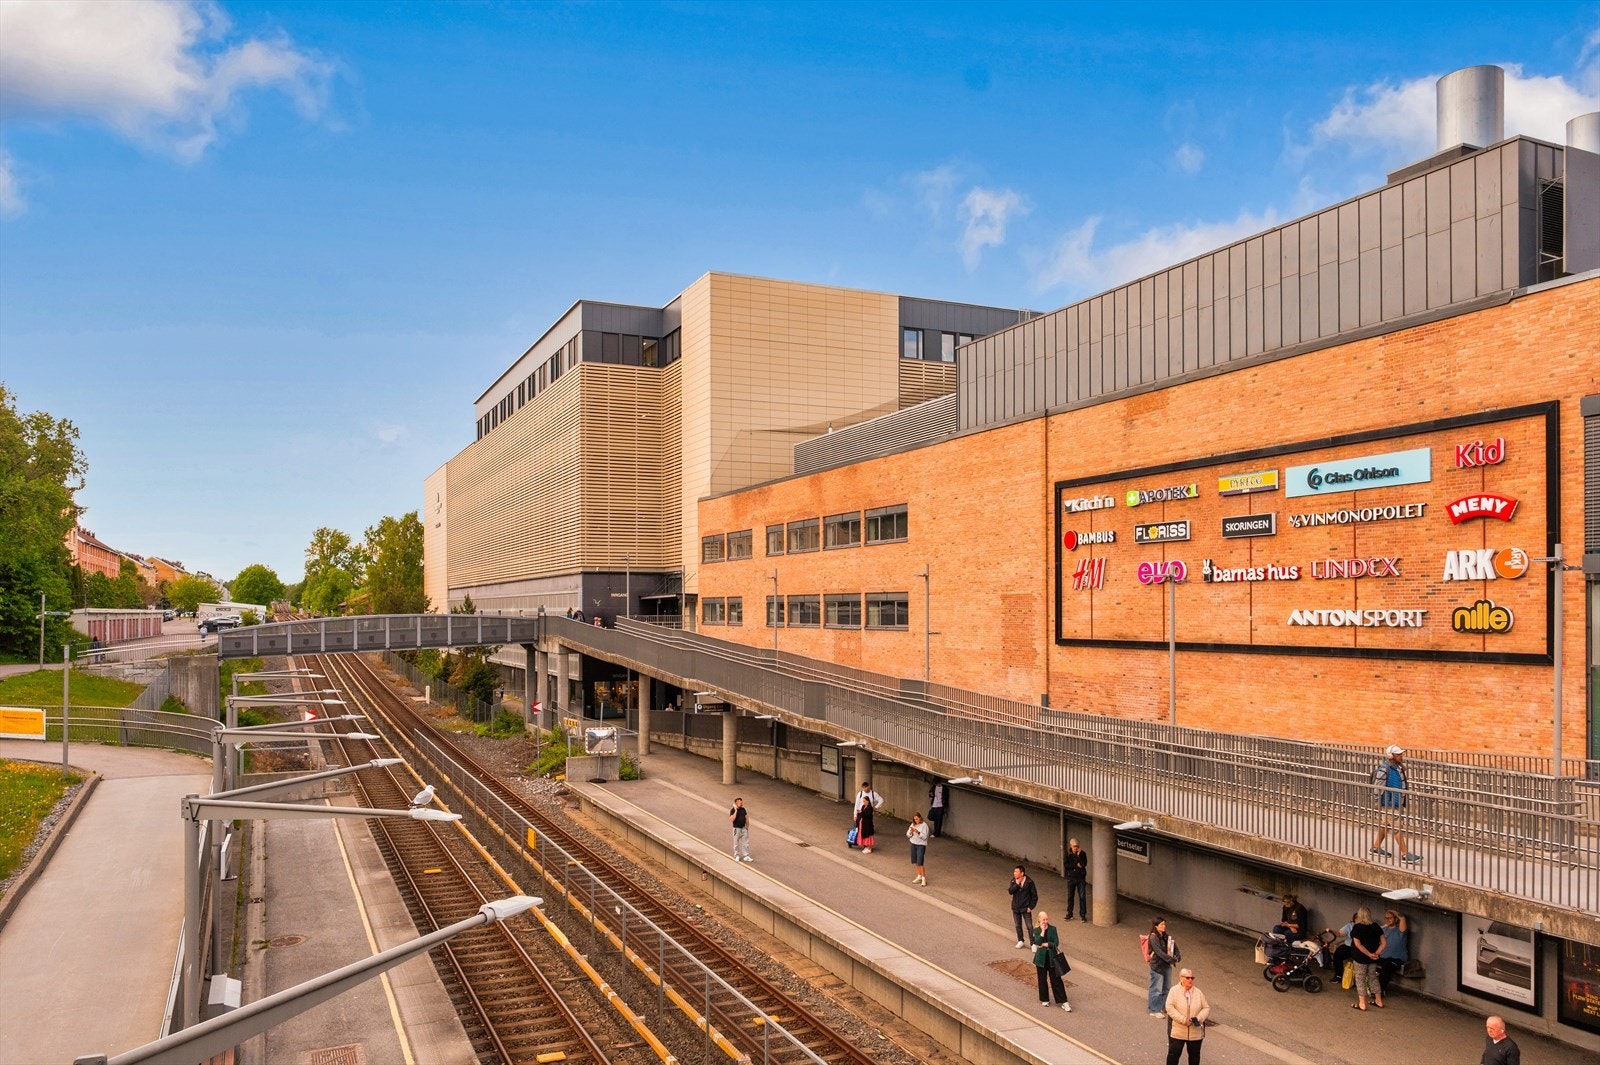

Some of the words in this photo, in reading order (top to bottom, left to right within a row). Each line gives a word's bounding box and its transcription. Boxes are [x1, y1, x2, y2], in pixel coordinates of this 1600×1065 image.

[1455, 437, 1505, 468] Kid
[1324, 472, 1353, 485] Clas
[1353, 466, 1400, 481] Ohlson
[1071, 494, 1115, 512] Kitch'n
[1450, 497, 1509, 518] MENY
[1301, 502, 1426, 526] VINMONOPOLET
[1135, 523, 1186, 540] FLORISS
[1225, 519, 1269, 532] SKORINGEN
[1077, 530, 1114, 545] BAMBUS
[1073, 557, 1106, 591] H&M
[1137, 560, 1188, 585] evo
[1213, 566, 1265, 582] barnas
[1267, 564, 1299, 580] hus
[1310, 557, 1400, 579] LINDEX
[1442, 548, 1497, 580] ARK
[1453, 601, 1509, 631] nille
